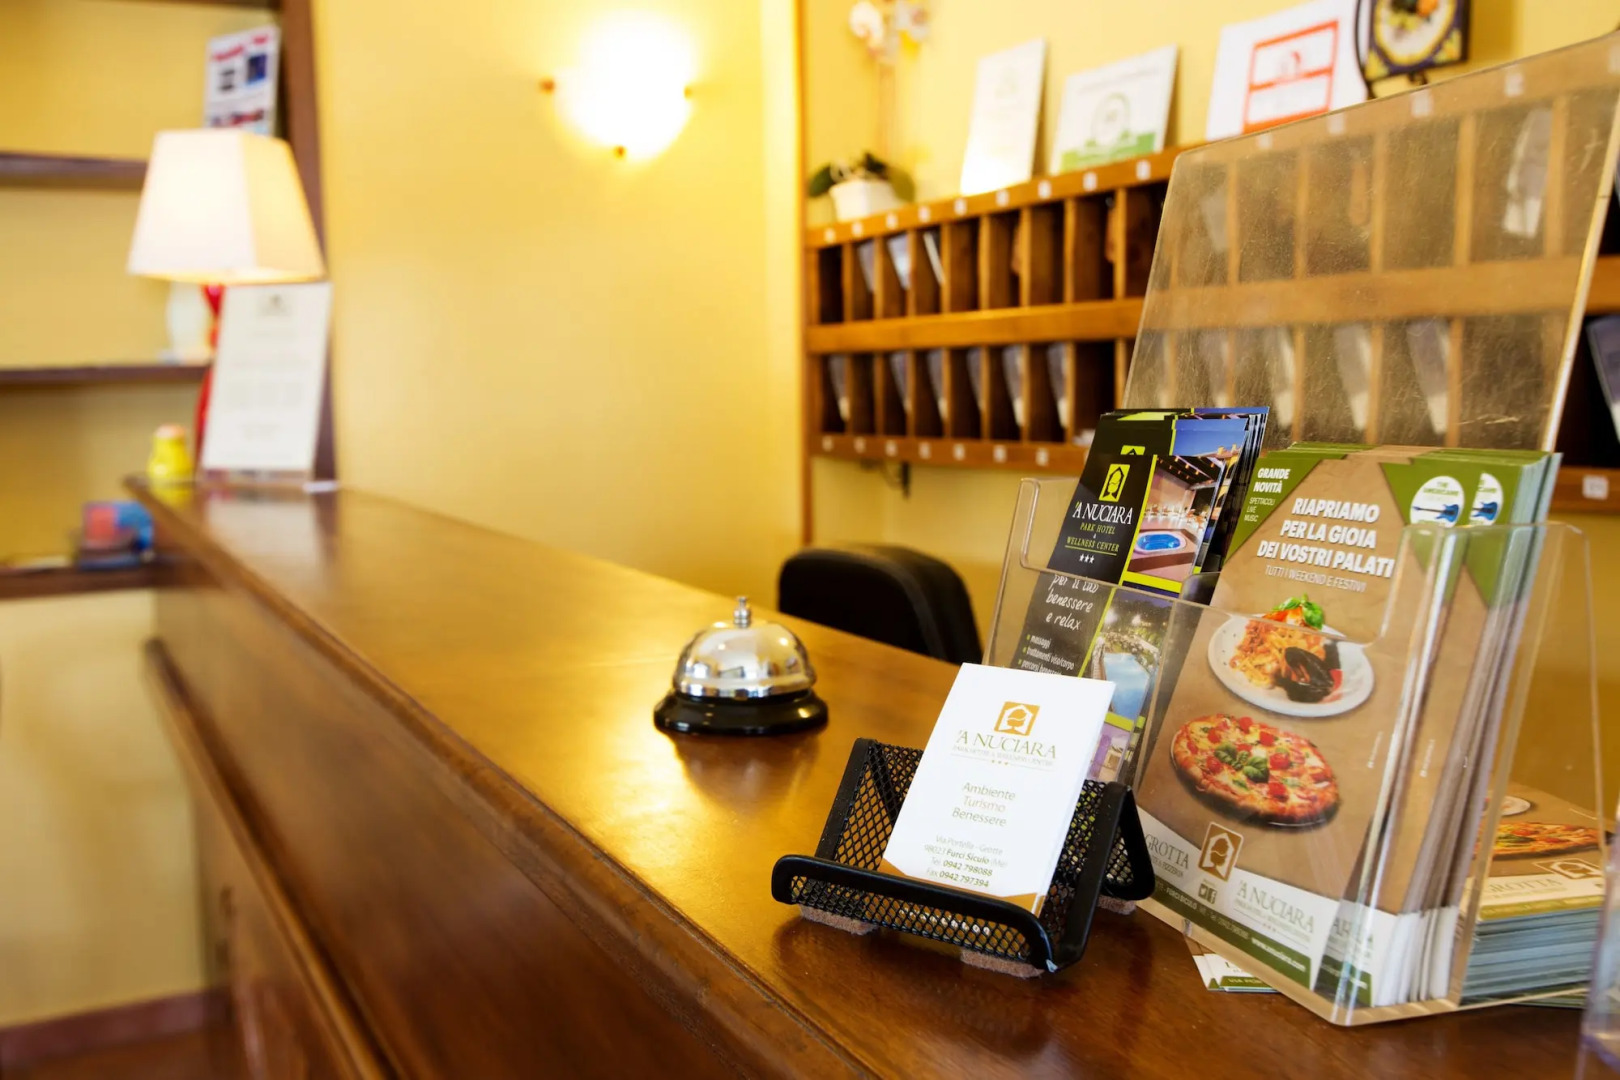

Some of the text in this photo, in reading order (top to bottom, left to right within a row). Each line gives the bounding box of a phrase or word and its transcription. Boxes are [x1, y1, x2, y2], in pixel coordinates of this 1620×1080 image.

[1257, 467, 1291, 480] GRANDE
[1253, 480, 1283, 493] NOVITÀ
[1082, 503, 1133, 524] NUCIARA
[1244, 514, 1259, 522] MUSIC
[1291, 497, 1380, 523] RIAPRIAMO
[1080, 522, 1116, 535] PARK HOTEL
[1280, 520, 1377, 549] PER LA GIOIA
[1066, 536, 1120, 552] WELLNESS CENTER
[1257, 540, 1395, 578] DEI VOSTRI PALATI
[1048, 573, 1068, 591] per
[1265, 565, 1284, 578] TUTTI
[1288, 569, 1326, 585] WEEKEND
[1332, 577, 1367, 592] FESTIVI
[1045, 588, 1094, 613] benessere
[1045, 612, 1082, 631] e relax
[1030, 634, 1052, 649] massaggi
[973, 732, 1056, 759] NUCIARA
[963, 782, 1016, 801] Ambiente
[963, 795, 1006, 813] Turismo
[952, 806, 1007, 827] Benessere
[946, 848, 965, 860] Furci
[966, 852, 990, 865] Siculo
[1145, 833, 1189, 869] GROTTA
[943, 859, 963, 871] 0942
[965, 864, 993, 877] 798088
[939, 870, 959, 882] 0942
[960, 875, 990, 888] 797394
[1249, 886, 1315, 934] NUCIARA
